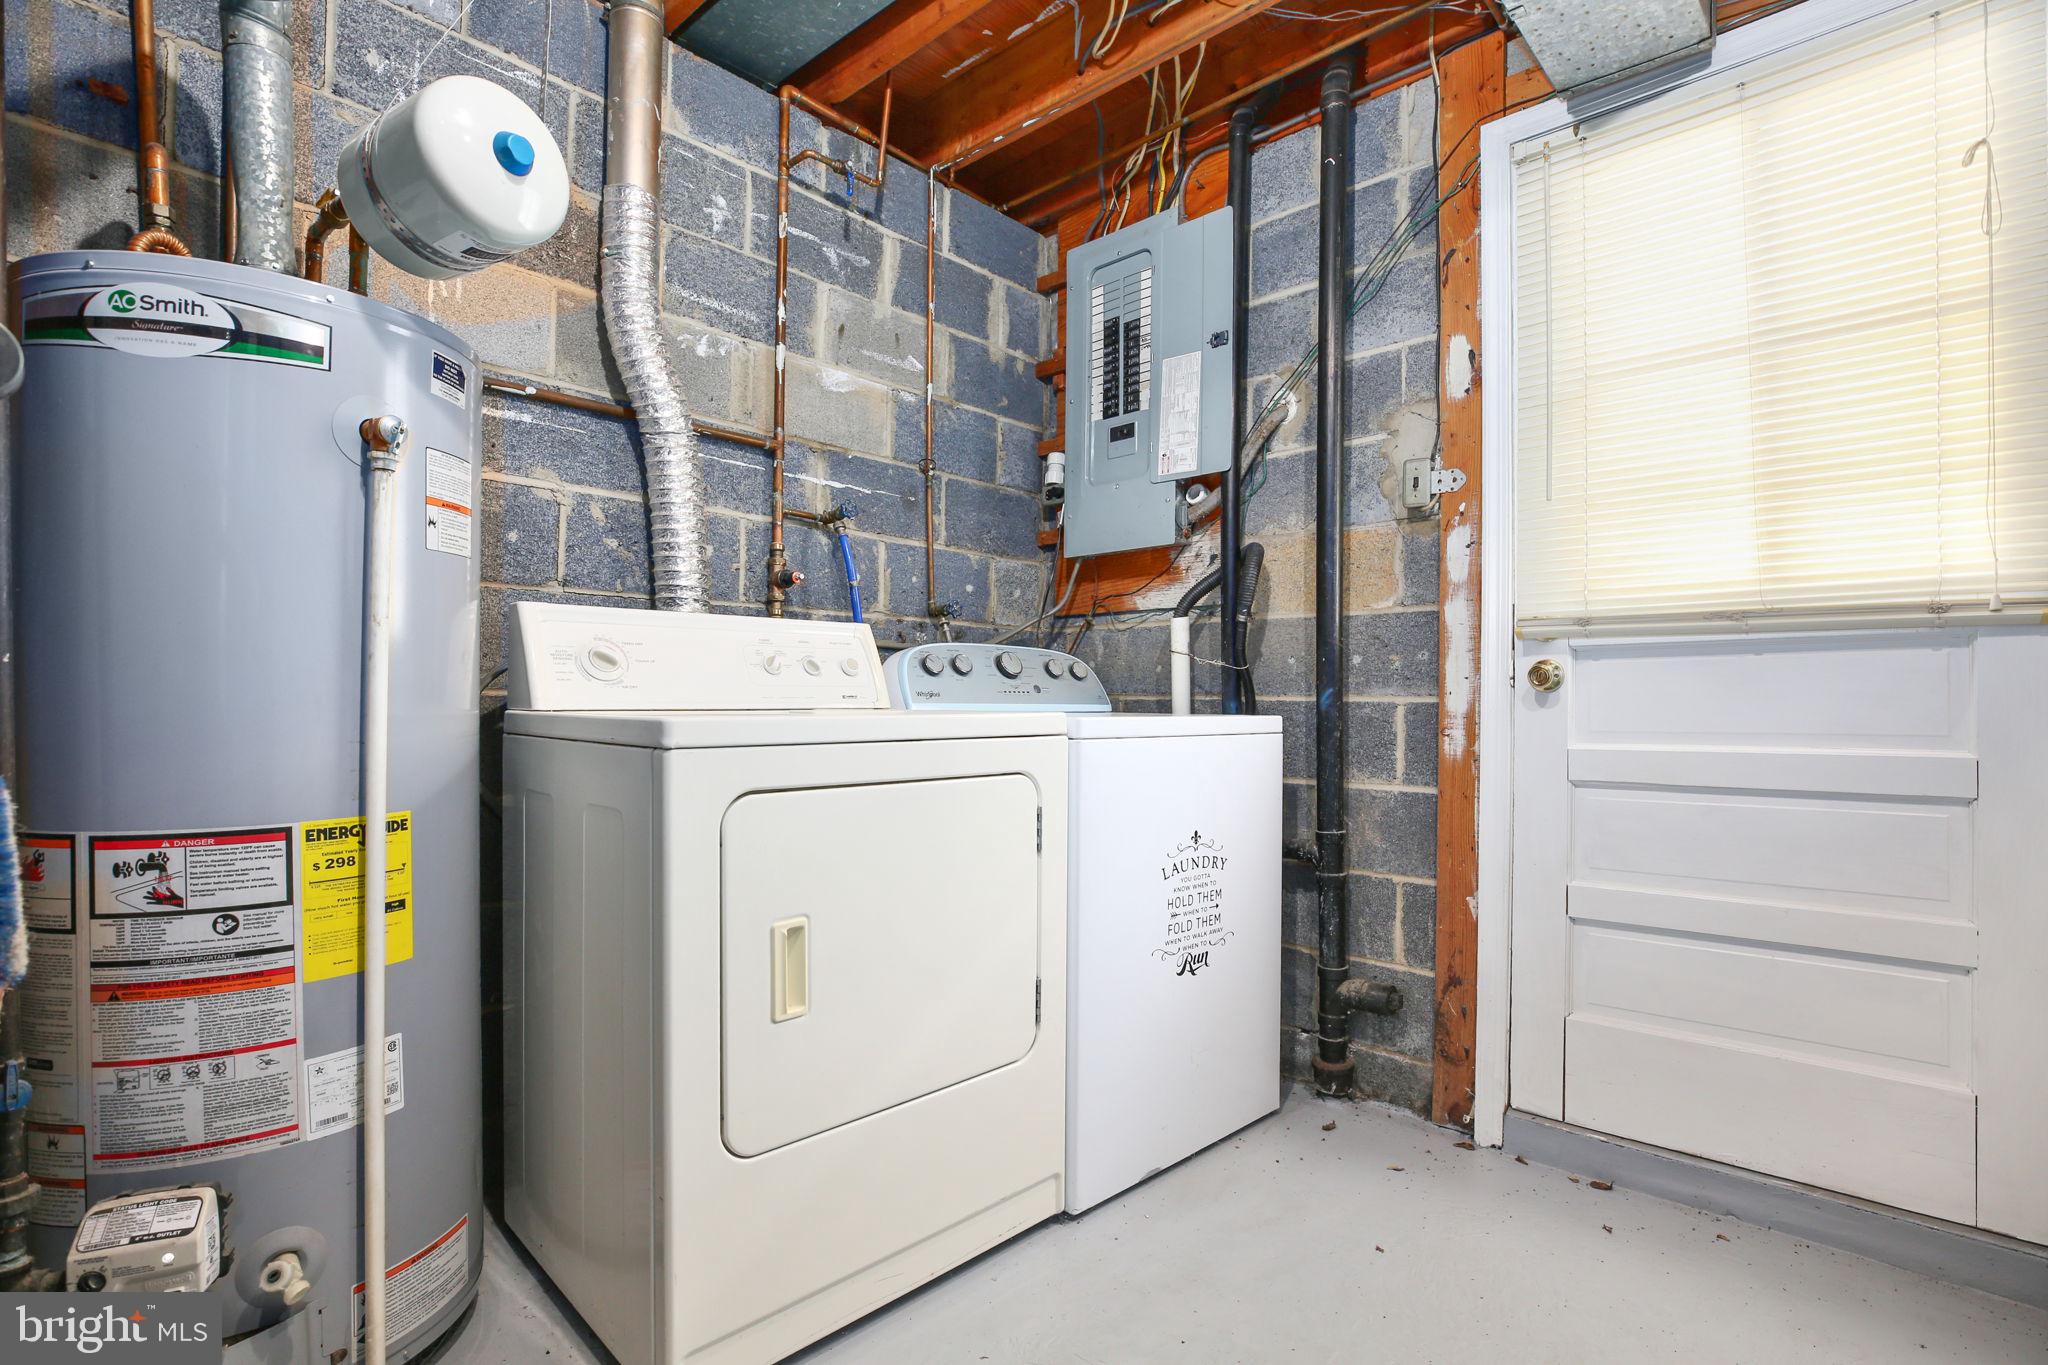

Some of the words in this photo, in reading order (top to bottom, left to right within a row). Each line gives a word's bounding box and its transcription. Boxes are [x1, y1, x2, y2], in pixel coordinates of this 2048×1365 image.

[173, 838, 215, 848] DANGER
[313, 862, 320, 871] $
[325, 856, 356, 869] 298
[1162, 856, 1228, 880] LAUNDRY
[1193, 873, 1210, 881] GOTTA
[1174, 885, 1191, 893] KNOW
[1192, 882, 1209, 890] WHEN
[1168, 895, 1193, 910] HOLD
[1197, 888, 1222, 903] THEM
[1168, 920, 1193, 936] FOLD
[1196, 913, 1221, 928] THEM
[1165, 938, 1181, 946] WHEN
[1182, 942, 1198, 951] WHEN
[1176, 951, 1210, 976] Run
[112, 1203, 138, 1212] STATUS
